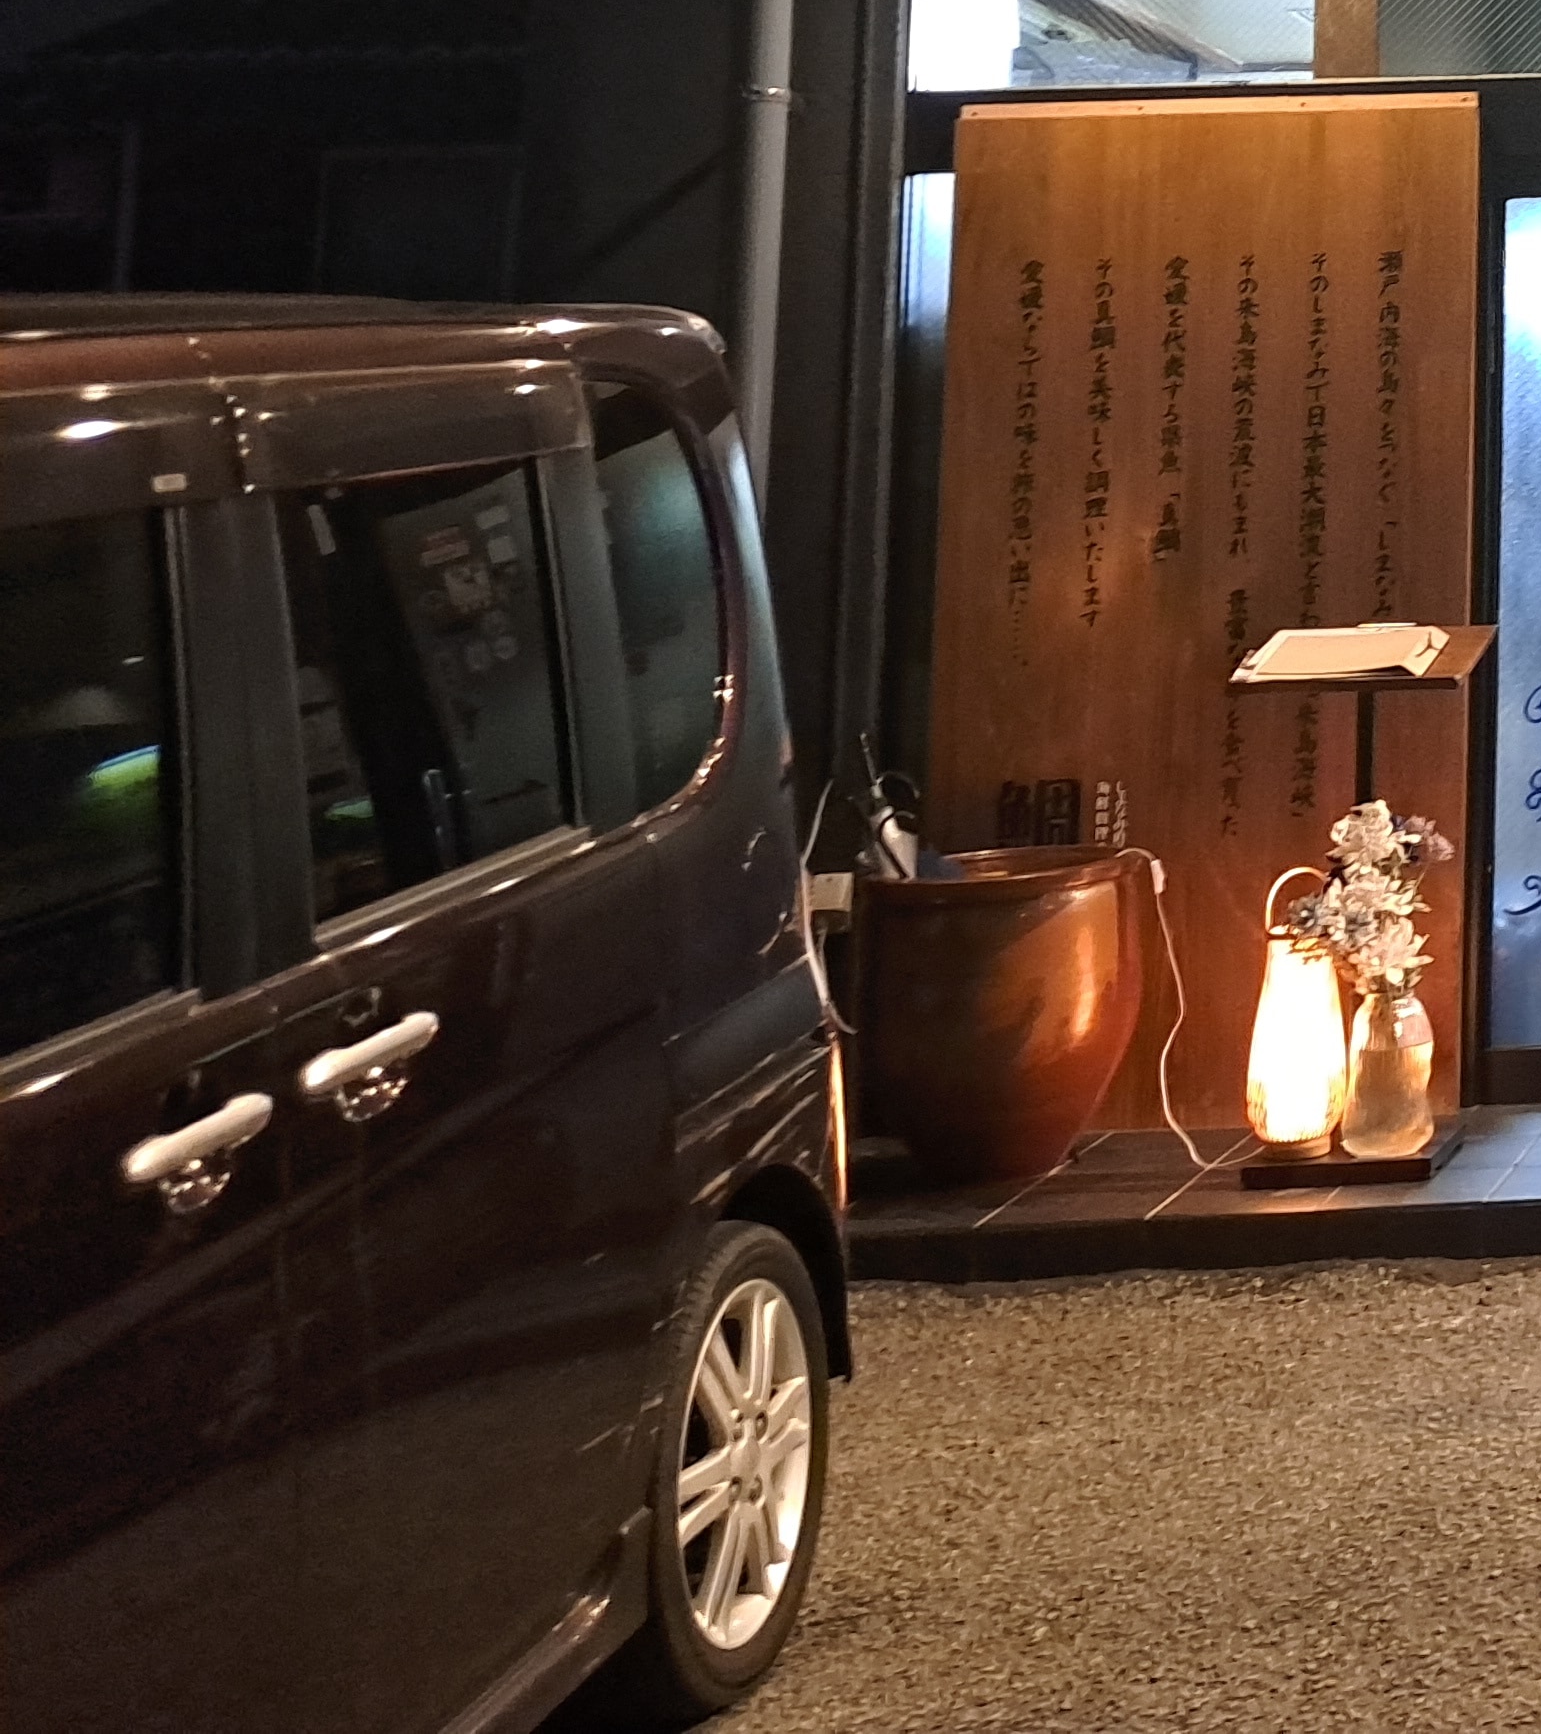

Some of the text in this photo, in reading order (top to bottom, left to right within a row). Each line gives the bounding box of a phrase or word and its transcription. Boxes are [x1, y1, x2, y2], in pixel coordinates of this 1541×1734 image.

[1372, 250, 1403, 617] 瀬戸内海の島々をつなぐ「しまなみ
